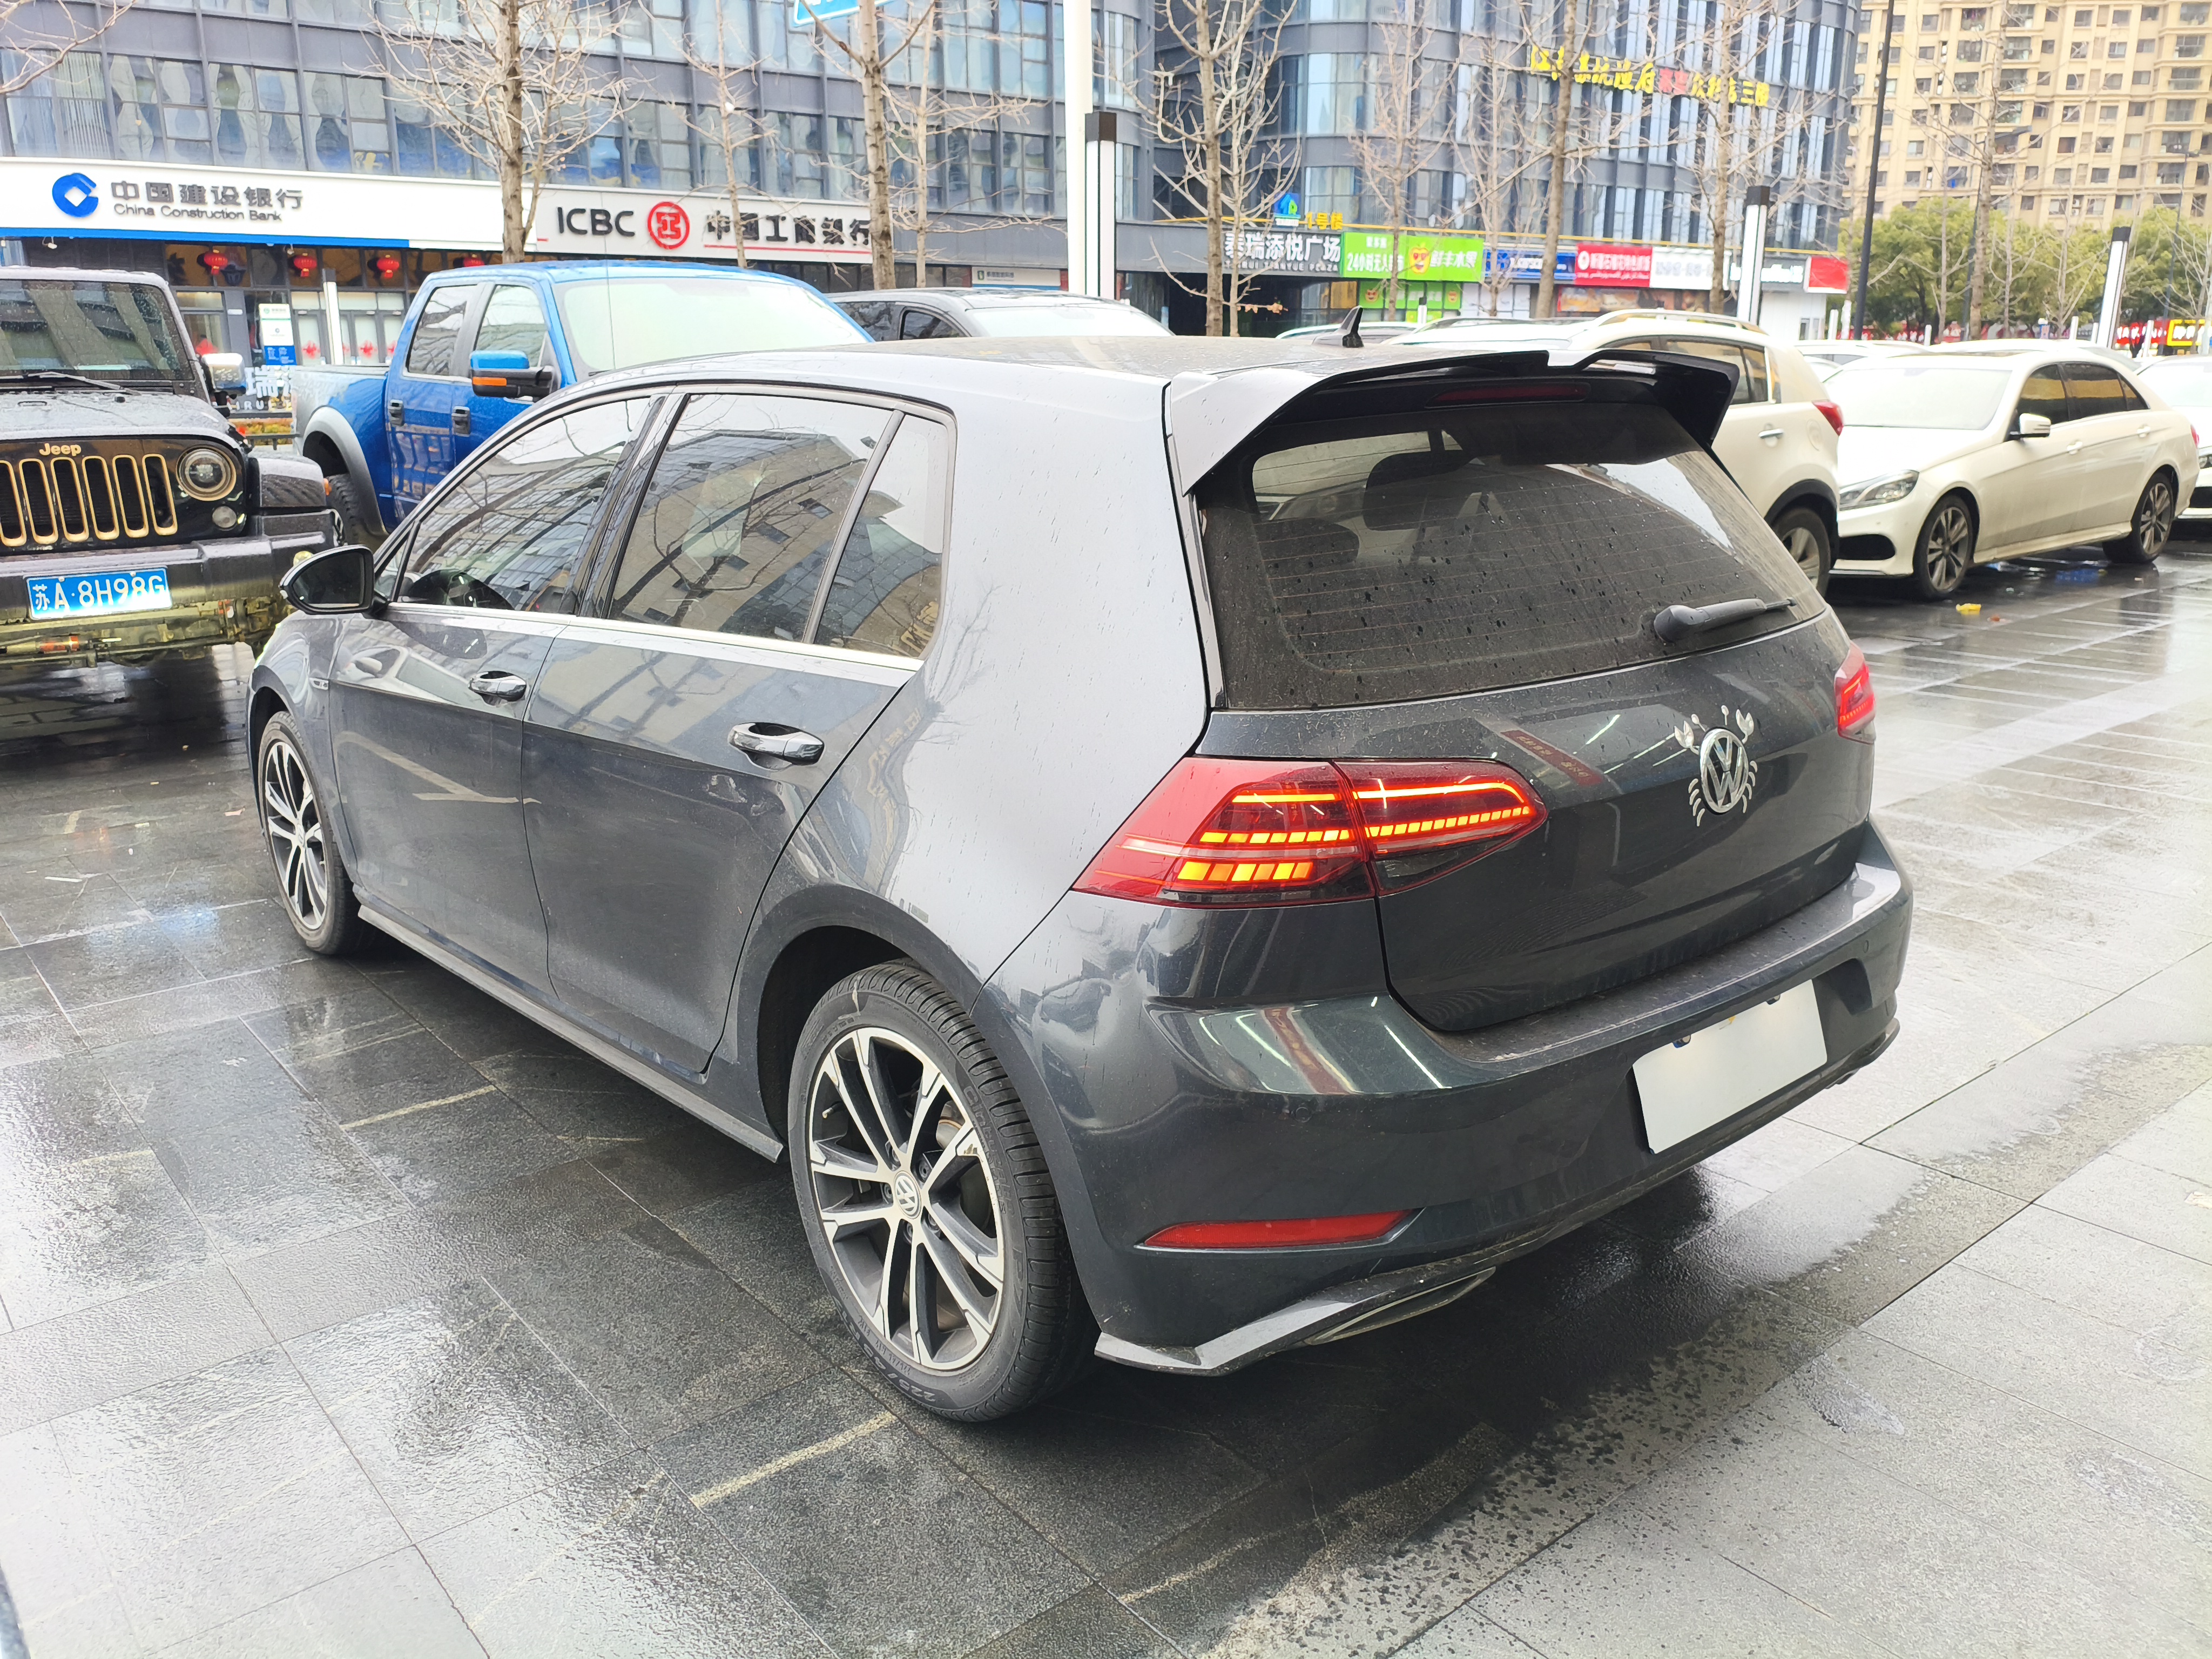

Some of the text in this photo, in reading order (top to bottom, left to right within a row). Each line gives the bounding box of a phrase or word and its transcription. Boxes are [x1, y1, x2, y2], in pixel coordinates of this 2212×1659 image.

[111, 180, 303, 209] 中国建设银行
[113, 203, 282, 221] China Construction Bank
[557, 206, 635, 237] ICBC
[1306, 211, 1343, 231] 1号楼
[39, 443, 82, 456] Jeep
